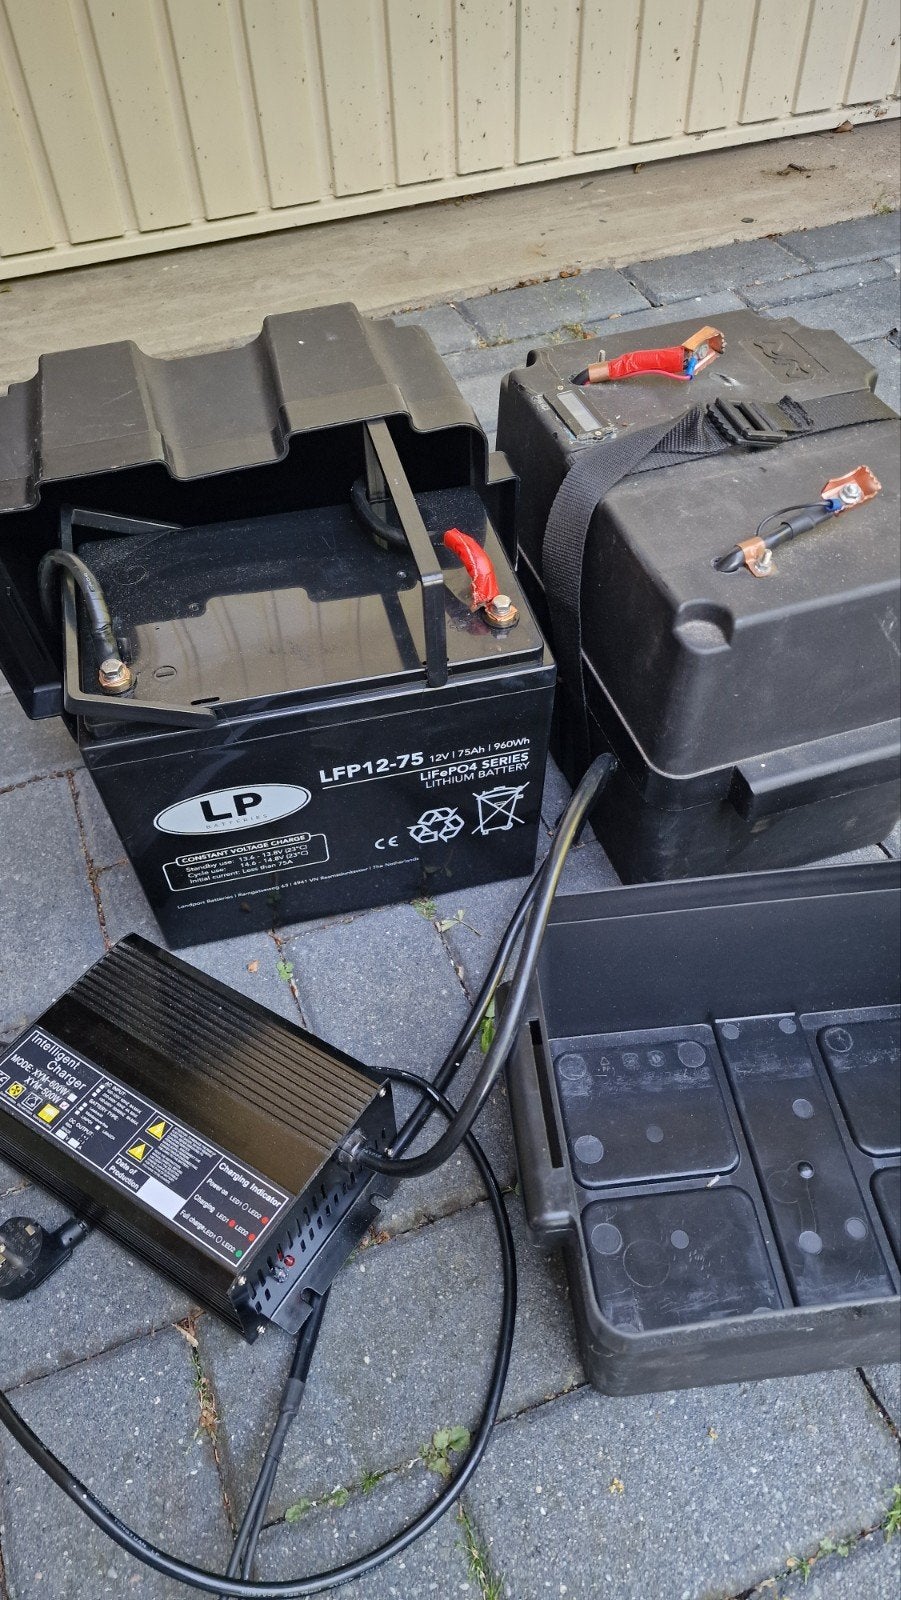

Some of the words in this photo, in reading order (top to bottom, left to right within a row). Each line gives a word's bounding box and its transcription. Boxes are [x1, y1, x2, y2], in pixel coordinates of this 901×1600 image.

[319, 752, 424, 783] LFP12-75
[429, 752, 450, 763] 12V
[458, 746, 485, 757] 75Ah
[493, 737, 530, 750] 960Wh
[420, 763, 478, 781] LiFePO4
[481, 752, 529, 769] SERIES
[425, 773, 475, 789] LITHIUM
[478, 761, 530, 779] BATTERY
[200, 792, 263, 822] LP
[205, 813, 269, 830] BATTERIES
[181, 850, 228, 863] CONSTANT
[230, 842, 269, 854] VOLTAGE
[270, 835, 306, 846] CHARGE
[185, 863, 217, 873] Standby
[187, 870, 209, 879] Cycle
[189, 875, 210, 884] Initial
[212, 870, 240, 880] current:
[279, 859, 294, 867] 75A
[31, 1034, 81, 1070] Intelligent
[10, 1054, 34, 1073] MODE:
[31, 1068, 71, 1096] XYM-600W
[46, 1060, 87, 1091] Charger
[24, 1076, 63, 1103] XYM-500W
[88, 1098, 108, 1113] BATTERY
[75, 1122, 94, 1138] OUTPUT:
[108, 1165, 140, 1191] Production
[114, 1157, 130, 1171] Date
[128, 1166, 138, 1176] of
[218, 1161, 250, 1188] Charging
[249, 1183, 282, 1208] Indicator
[206, 1178, 222, 1192] Power
[247, 1207, 262, 1220] LED2
[193, 1193, 216, 1213] Charging
[234, 1224, 249, 1237] LED2
[179, 1209, 190, 1222] Full
[221, 1240, 236, 1253] LED2
